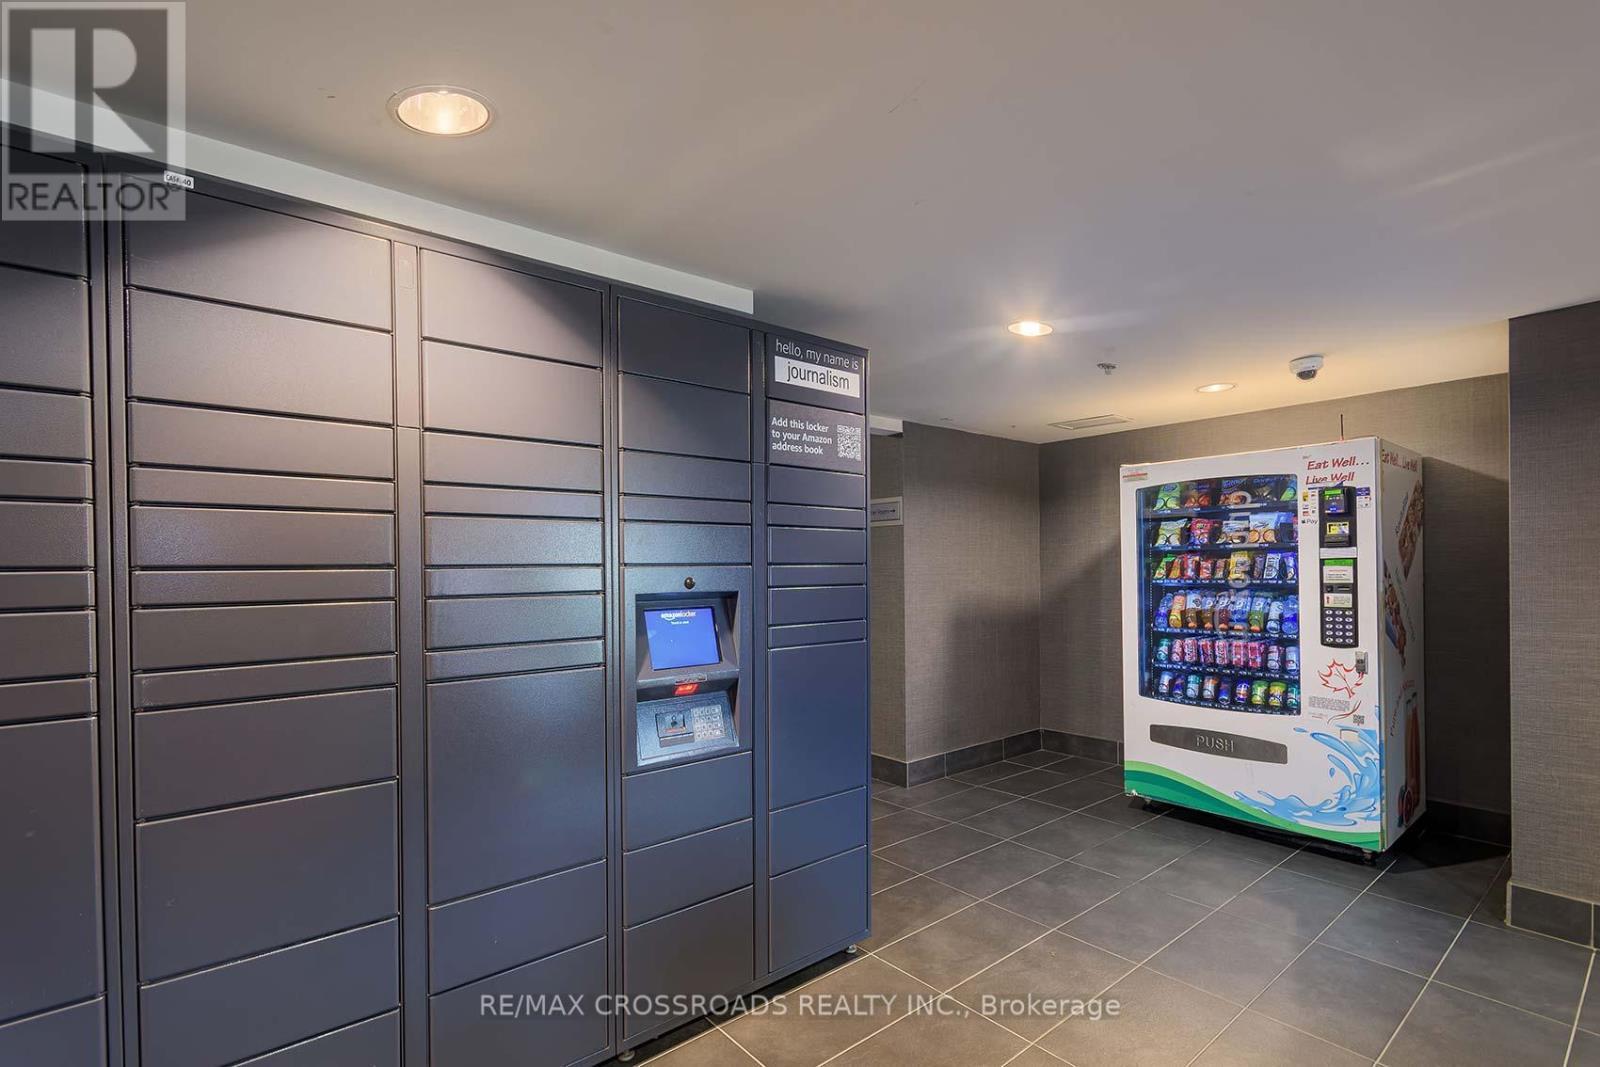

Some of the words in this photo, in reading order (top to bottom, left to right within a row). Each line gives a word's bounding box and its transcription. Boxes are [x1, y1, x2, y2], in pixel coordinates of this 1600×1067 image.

[775, 338, 803, 359] hello,
[806, 349, 821, 364] my
[823, 353, 850, 368] name
[851, 358, 859, 370] is
[786, 361, 850, 390] journalism
[771, 417, 788, 427] Add
[790, 419, 804, 430] this
[806, 421, 829, 433] locker
[772, 429, 780, 437] to
[782, 432, 800, 441] your
[802, 432, 832, 444] Amazon
[772, 441, 803, 453] address
[804, 445, 824, 455] book
[1307, 460, 1329, 470] Eat
[1306, 476, 1328, 485] Live
[1331, 472, 1355, 482] Well
[1196, 735, 1234, 753] PUSH
